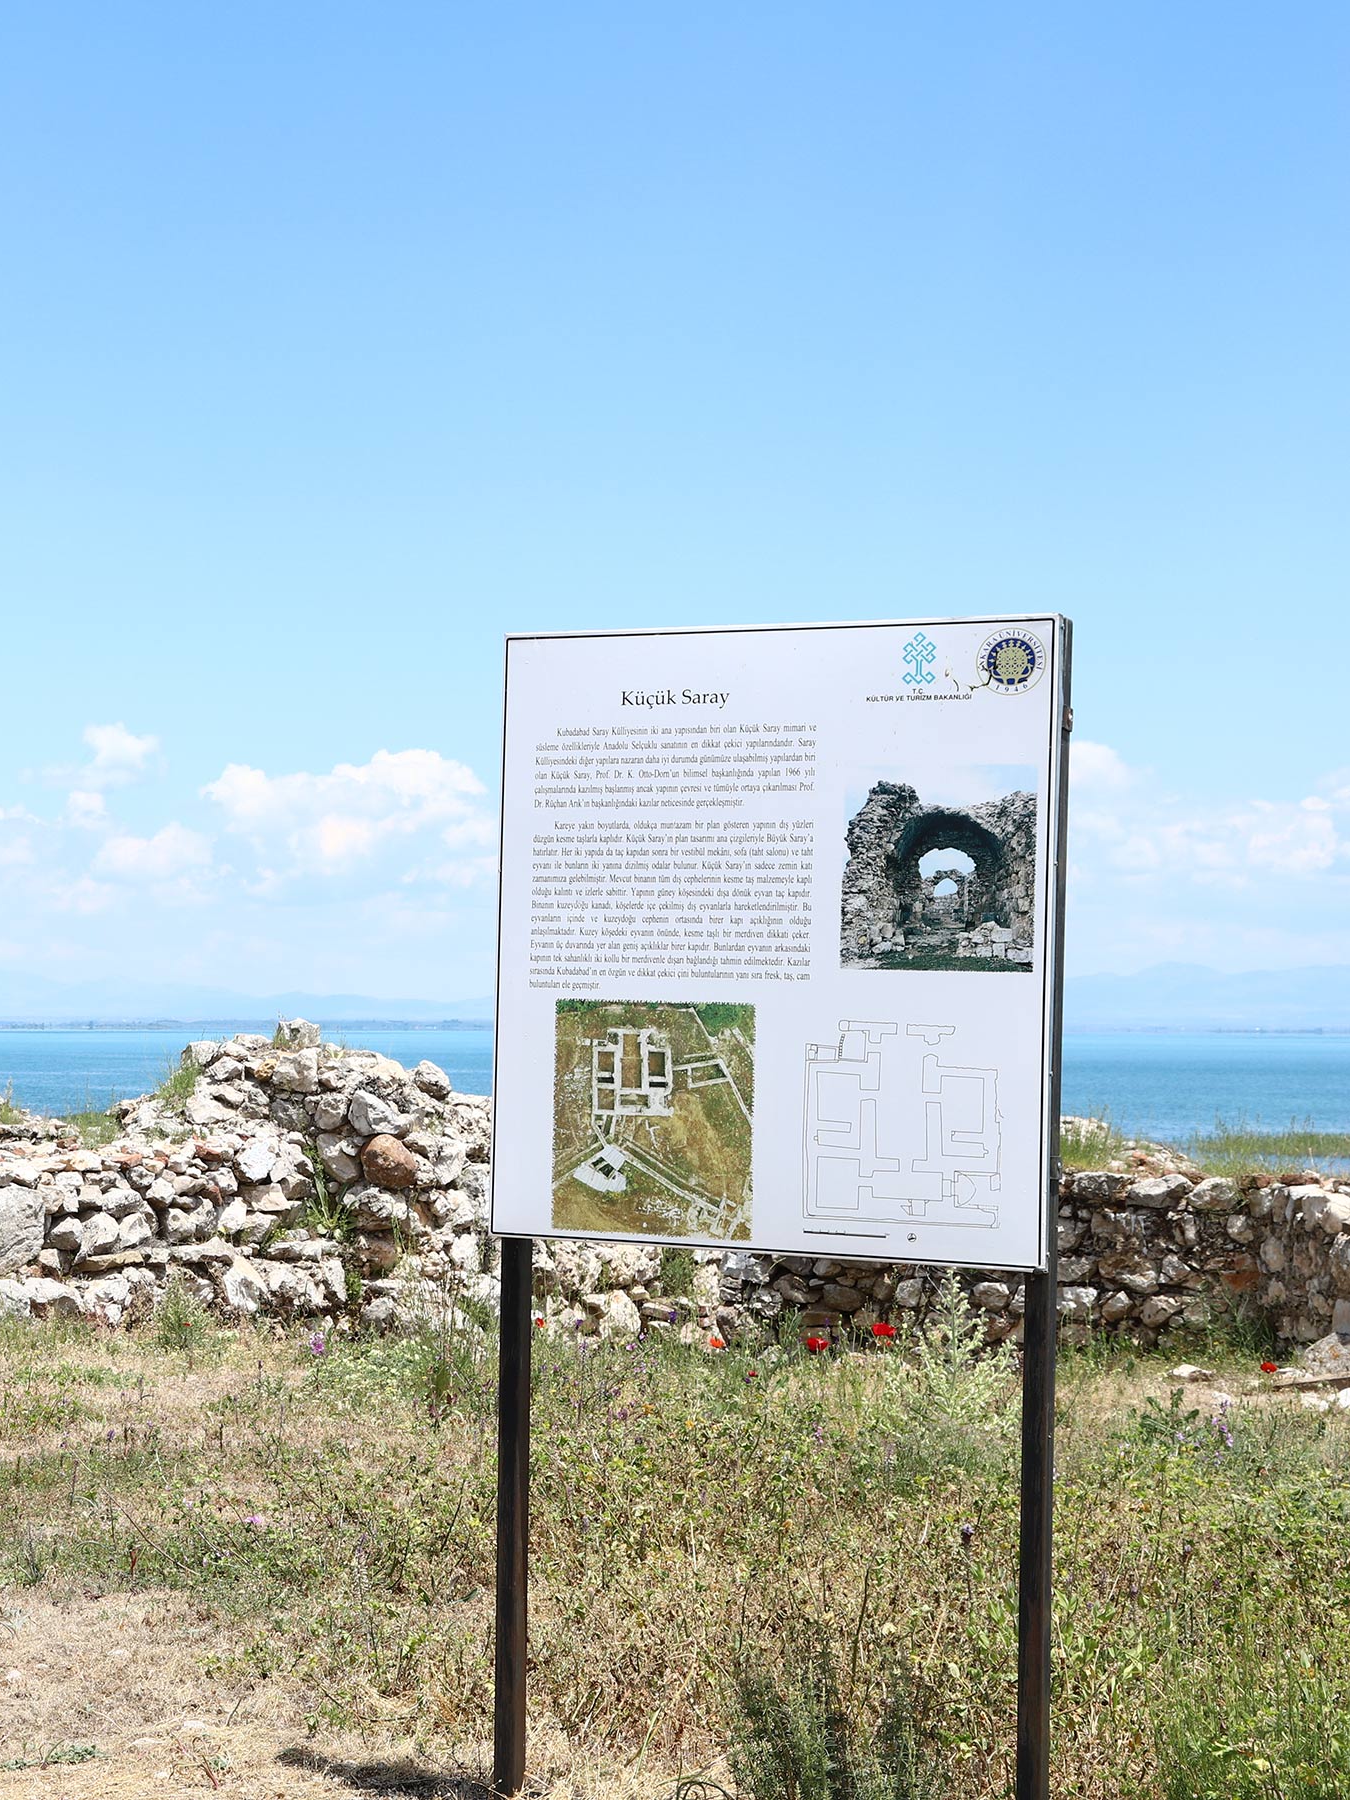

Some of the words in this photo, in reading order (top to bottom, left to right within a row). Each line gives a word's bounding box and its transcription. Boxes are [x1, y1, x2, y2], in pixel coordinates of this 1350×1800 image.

[995, 684, 1028, 692] 1946
[621, 689, 676, 710] Küçük
[681, 688, 730, 709] Saray
[557, 727, 590, 735] Kubadabad
[592, 726, 609, 738] Saray
[650, 726, 659, 734] iki
[709, 725, 721, 733] biri
[723, 725, 737, 733] olan
[739, 724, 760, 736] Küçük
[762, 724, 780, 736] Saray
[783, 724, 806, 732] mimari
[536, 742, 559, 750] süsleme
[603, 741, 629, 749] Anadolu
[631, 740, 658, 752] Selçuklu
[701, 740, 721, 748] dikkat
[723, 739, 742, 751] çekici
[798, 738, 816, 750] Saray
[578, 756, 594, 767] diğer
[645, 755, 660, 763] daha
[661, 755, 670, 766] iyi
[670, 754, 698, 763] durumda
[699, 754, 731, 766] günümüze
[804, 753, 816, 762] biri
[535, 770, 548, 779] olan
[551, 770, 570, 781] Küçük
[573, 770, 593, 781] Saray,
[595, 770, 613, 778] Prof.
[614, 770, 624, 778] Dr.
[683, 769, 708, 777] bilimsel
[785, 768, 801, 777] 1966
[636, 784, 653, 792] ancak
[680, 784, 702, 795] çevresi
[713, 783, 739, 795] tümüyle
[740, 783, 760, 795] ortaya
[799, 783, 815, 791] Prof.
[534, 799, 544, 807] Dr.
[554, 821, 575, 832] Kareye
[633, 820, 657, 832] oldukça
[694, 820, 704, 829] bir
[706, 820, 720, 832] plan
[723, 820, 750, 832] gösteren
[792, 820, 814, 832] yüzleri
[532, 834, 555, 845] düzgün
[556, 834, 575, 842] kesme
[576, 834, 598, 845] taşlarla
[626, 834, 646, 845] Küçük
[675, 834, 689, 845] plan
[766, 834, 787, 845] Büyük
[789, 834, 814, 845] Saray'a
[561, 847, 572, 855] Her
[574, 847, 582, 856] iki
[614, 847, 624, 859] taç
[670, 847, 679, 856] bir
[681, 847, 705, 856] vestibül
[734, 847, 747, 856] sofa
[748, 847, 764, 858] (taht
[766, 847, 789, 858] salonu)
[801, 848, 813, 856] taht
[554, 860, 562, 869] ile
[591, 860, 600, 869] iki
[651, 861, 671, 869] odalar
[673, 861, 699, 869] bulunur.
[701, 861, 722, 872] Küçük
[754, 861, 775, 870] sadece
[778, 861, 798, 870] zemin
[609, 874, 632, 882] Mevcut
[658, 874, 671, 883] tüm
[723, 874, 743, 883] kesme
[745, 875, 754, 886] taş
[756, 875, 794, 887] malzemeyle
[531, 887, 552, 898] olduğu
[585, 887, 603, 896] izlerle
[657, 888, 675, 899] güney
[731, 888, 751, 897] dönük
[754, 891, 773, 900] eyvan
[775, 888, 785, 900] taç
[556, 900, 589, 912] kuzeydoğu
[615, 901, 644, 912] köşelerde
[646, 901, 656, 913] içe
[658, 901, 685, 913] çekilmiş
[699, 901, 731, 913] eyvanlarla
[566, 913, 585, 925] içinde
[603, 914, 636, 926] kuzeydoğu
[641, 914, 669, 926] cephenin
[709, 915, 724, 924] birer
[789, 916, 812, 928] olduğu
[579, 927, 598, 939] Kuzey
[601, 927, 628, 939] köşedeki
[684, 928, 704, 937] kesme
[722, 929, 731, 937] bir
[734, 929, 764, 938] merdiven
[766, 929, 789, 938] dikkati
[791, 930, 810, 942] çeker.
[596, 943, 606, 952] yer
[608, 941, 621, 949] alan
[622, 941, 639, 953] geniş
[671, 942, 686, 950] birer
[713, 942, 746, 951] Bunlardan
[553, 953, 562, 962] tek
[594, 954, 603, 962] iki
[604, 954, 620, 963] kollu
[621, 954, 630, 963] bir
[631, 954, 665, 963] merdivenle
[720, 956, 742, 965] tahmin
[607, 967, 627, 979] özgün
[637, 968, 656, 977] dikkat
[657, 968, 676, 980] çekici
[677, 969, 689, 980] çini
[764, 970, 782, 981] fresk,
[783, 971, 795, 983] taş,
[561, 980, 571, 988] ele
